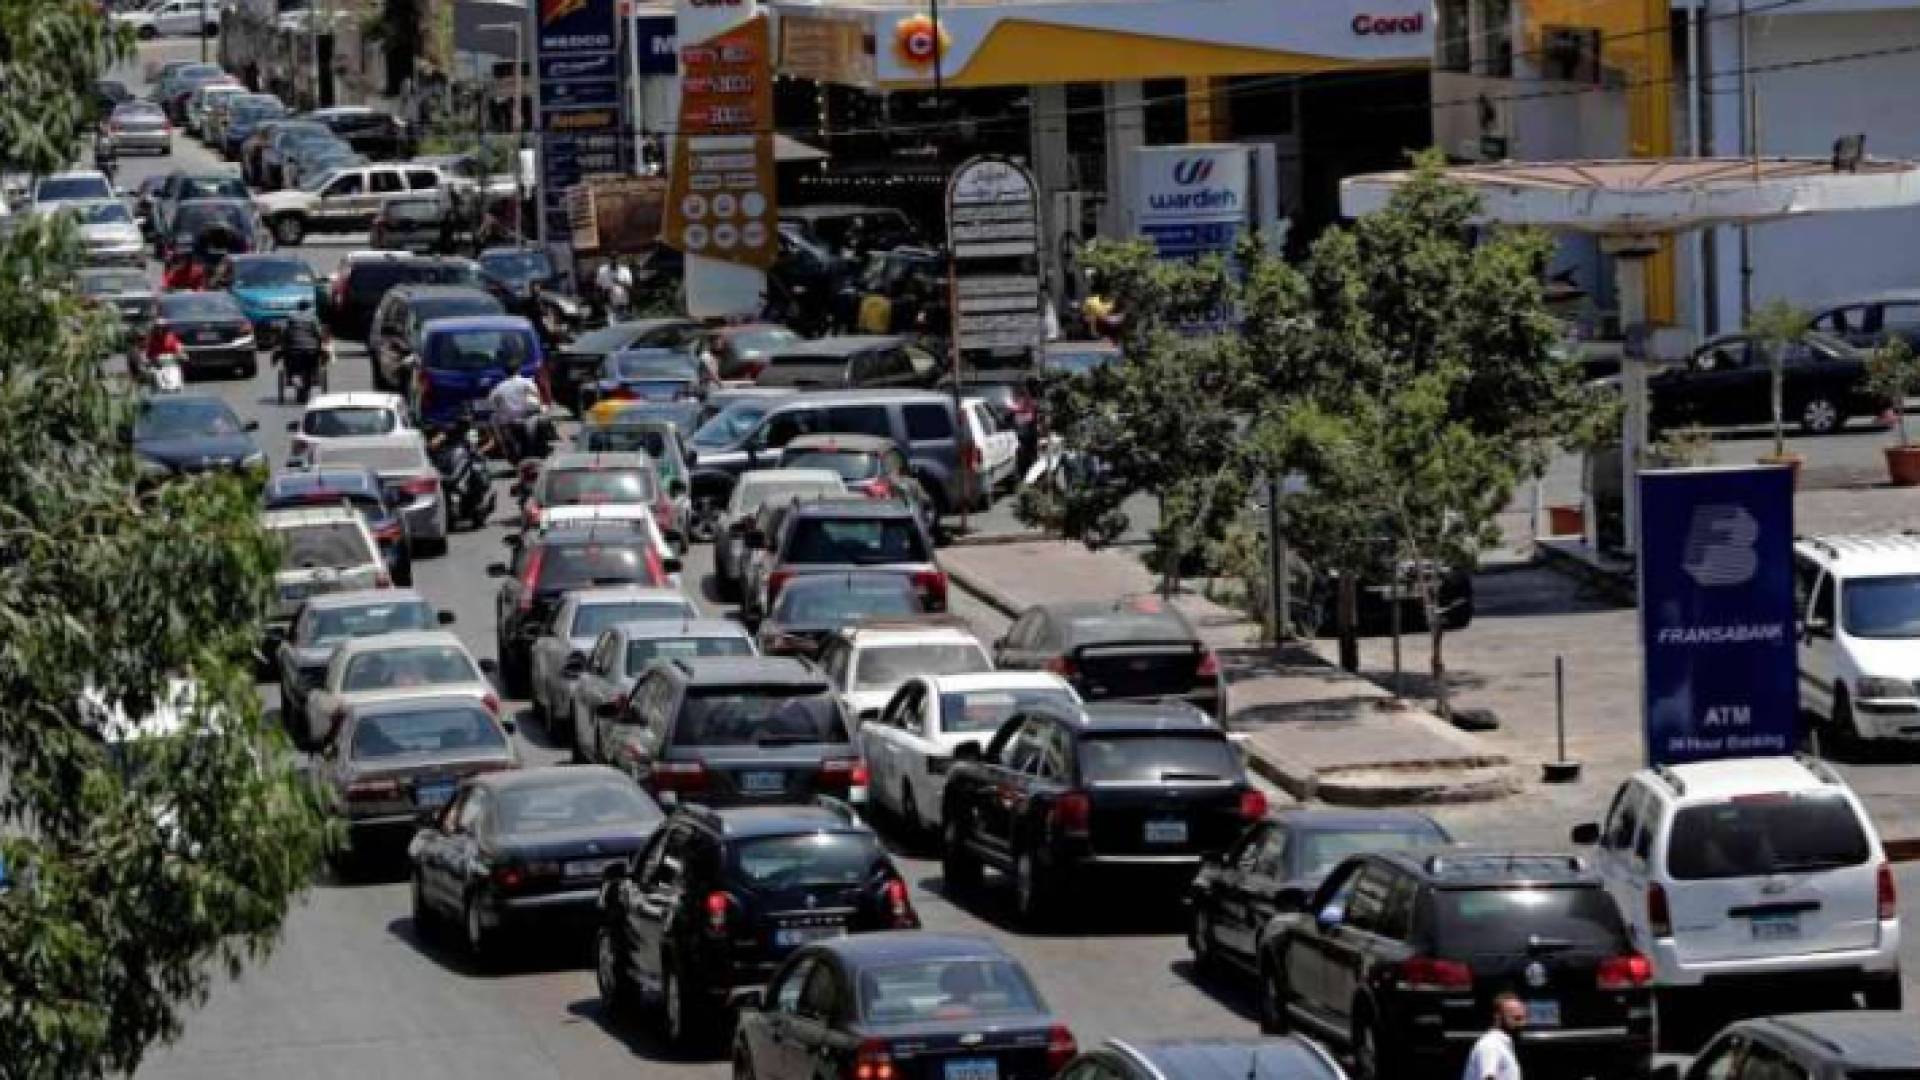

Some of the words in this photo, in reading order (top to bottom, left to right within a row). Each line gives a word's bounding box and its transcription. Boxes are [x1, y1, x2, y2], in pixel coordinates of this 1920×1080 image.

[1352, 13, 1424, 34] Coral
[1149, 188, 1238, 209] wardieh
[1658, 624, 1783, 643] FRANSABANK
[1704, 706, 1751, 725] ATM
